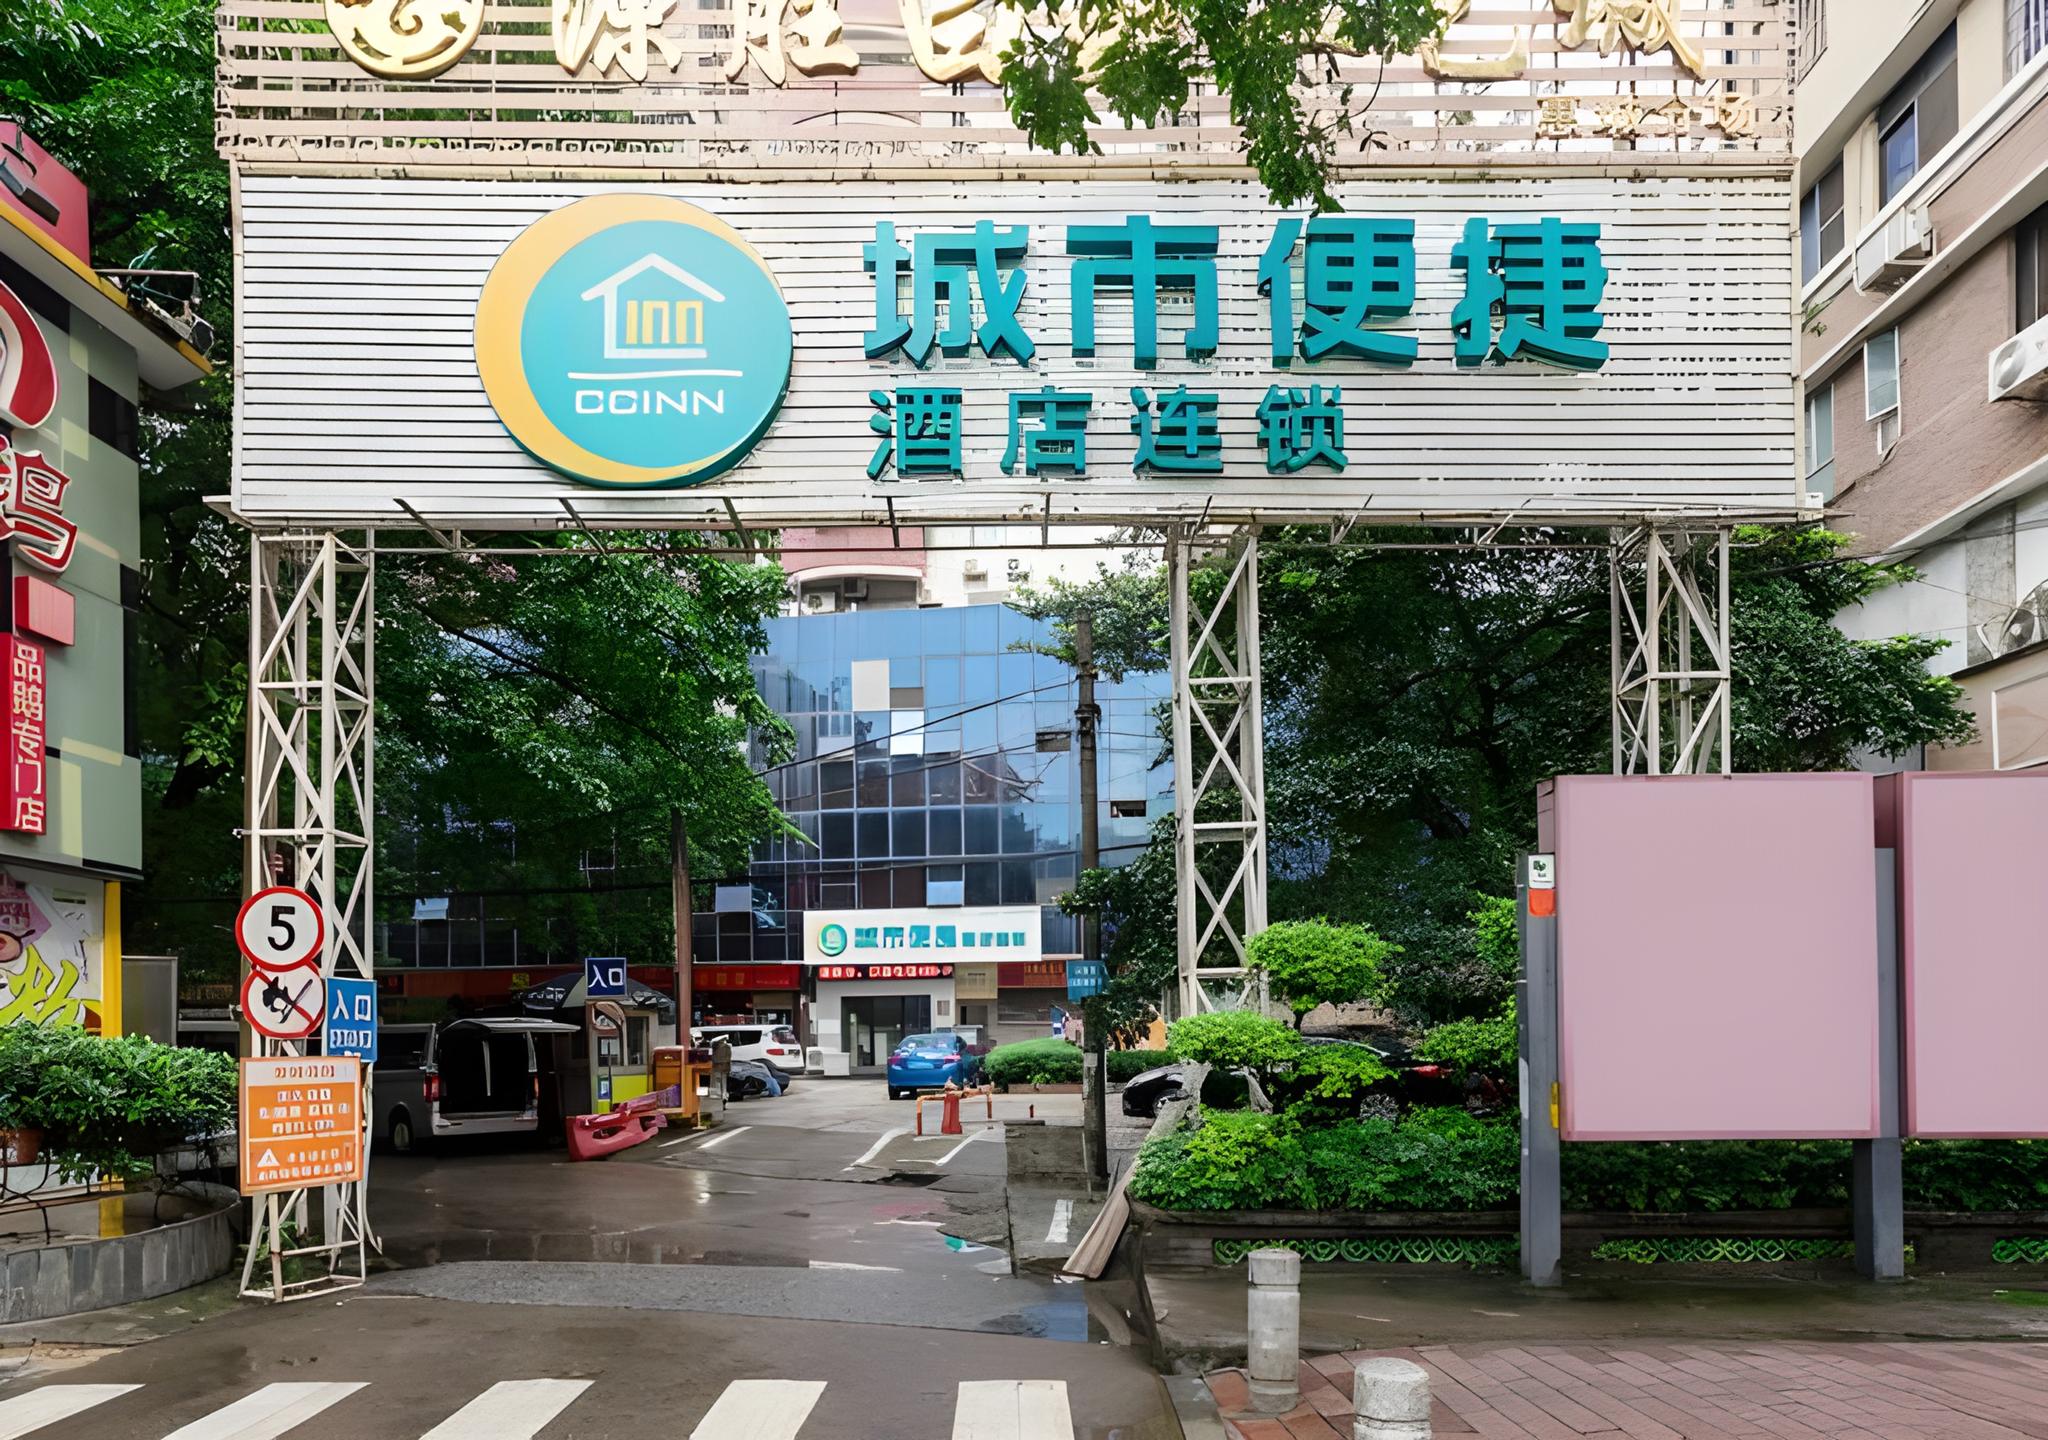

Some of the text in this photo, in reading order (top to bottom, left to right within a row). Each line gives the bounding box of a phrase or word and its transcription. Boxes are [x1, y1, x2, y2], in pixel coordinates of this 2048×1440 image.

[864, 214, 1609, 369] 城市便捷
[575, 389, 725, 415] CCINN
[869, 384, 1349, 482] 酒店连锁
[267, 905, 296, 951] 5
[588, 964, 624, 988] 入口
[332, 989, 371, 1021] 入口
